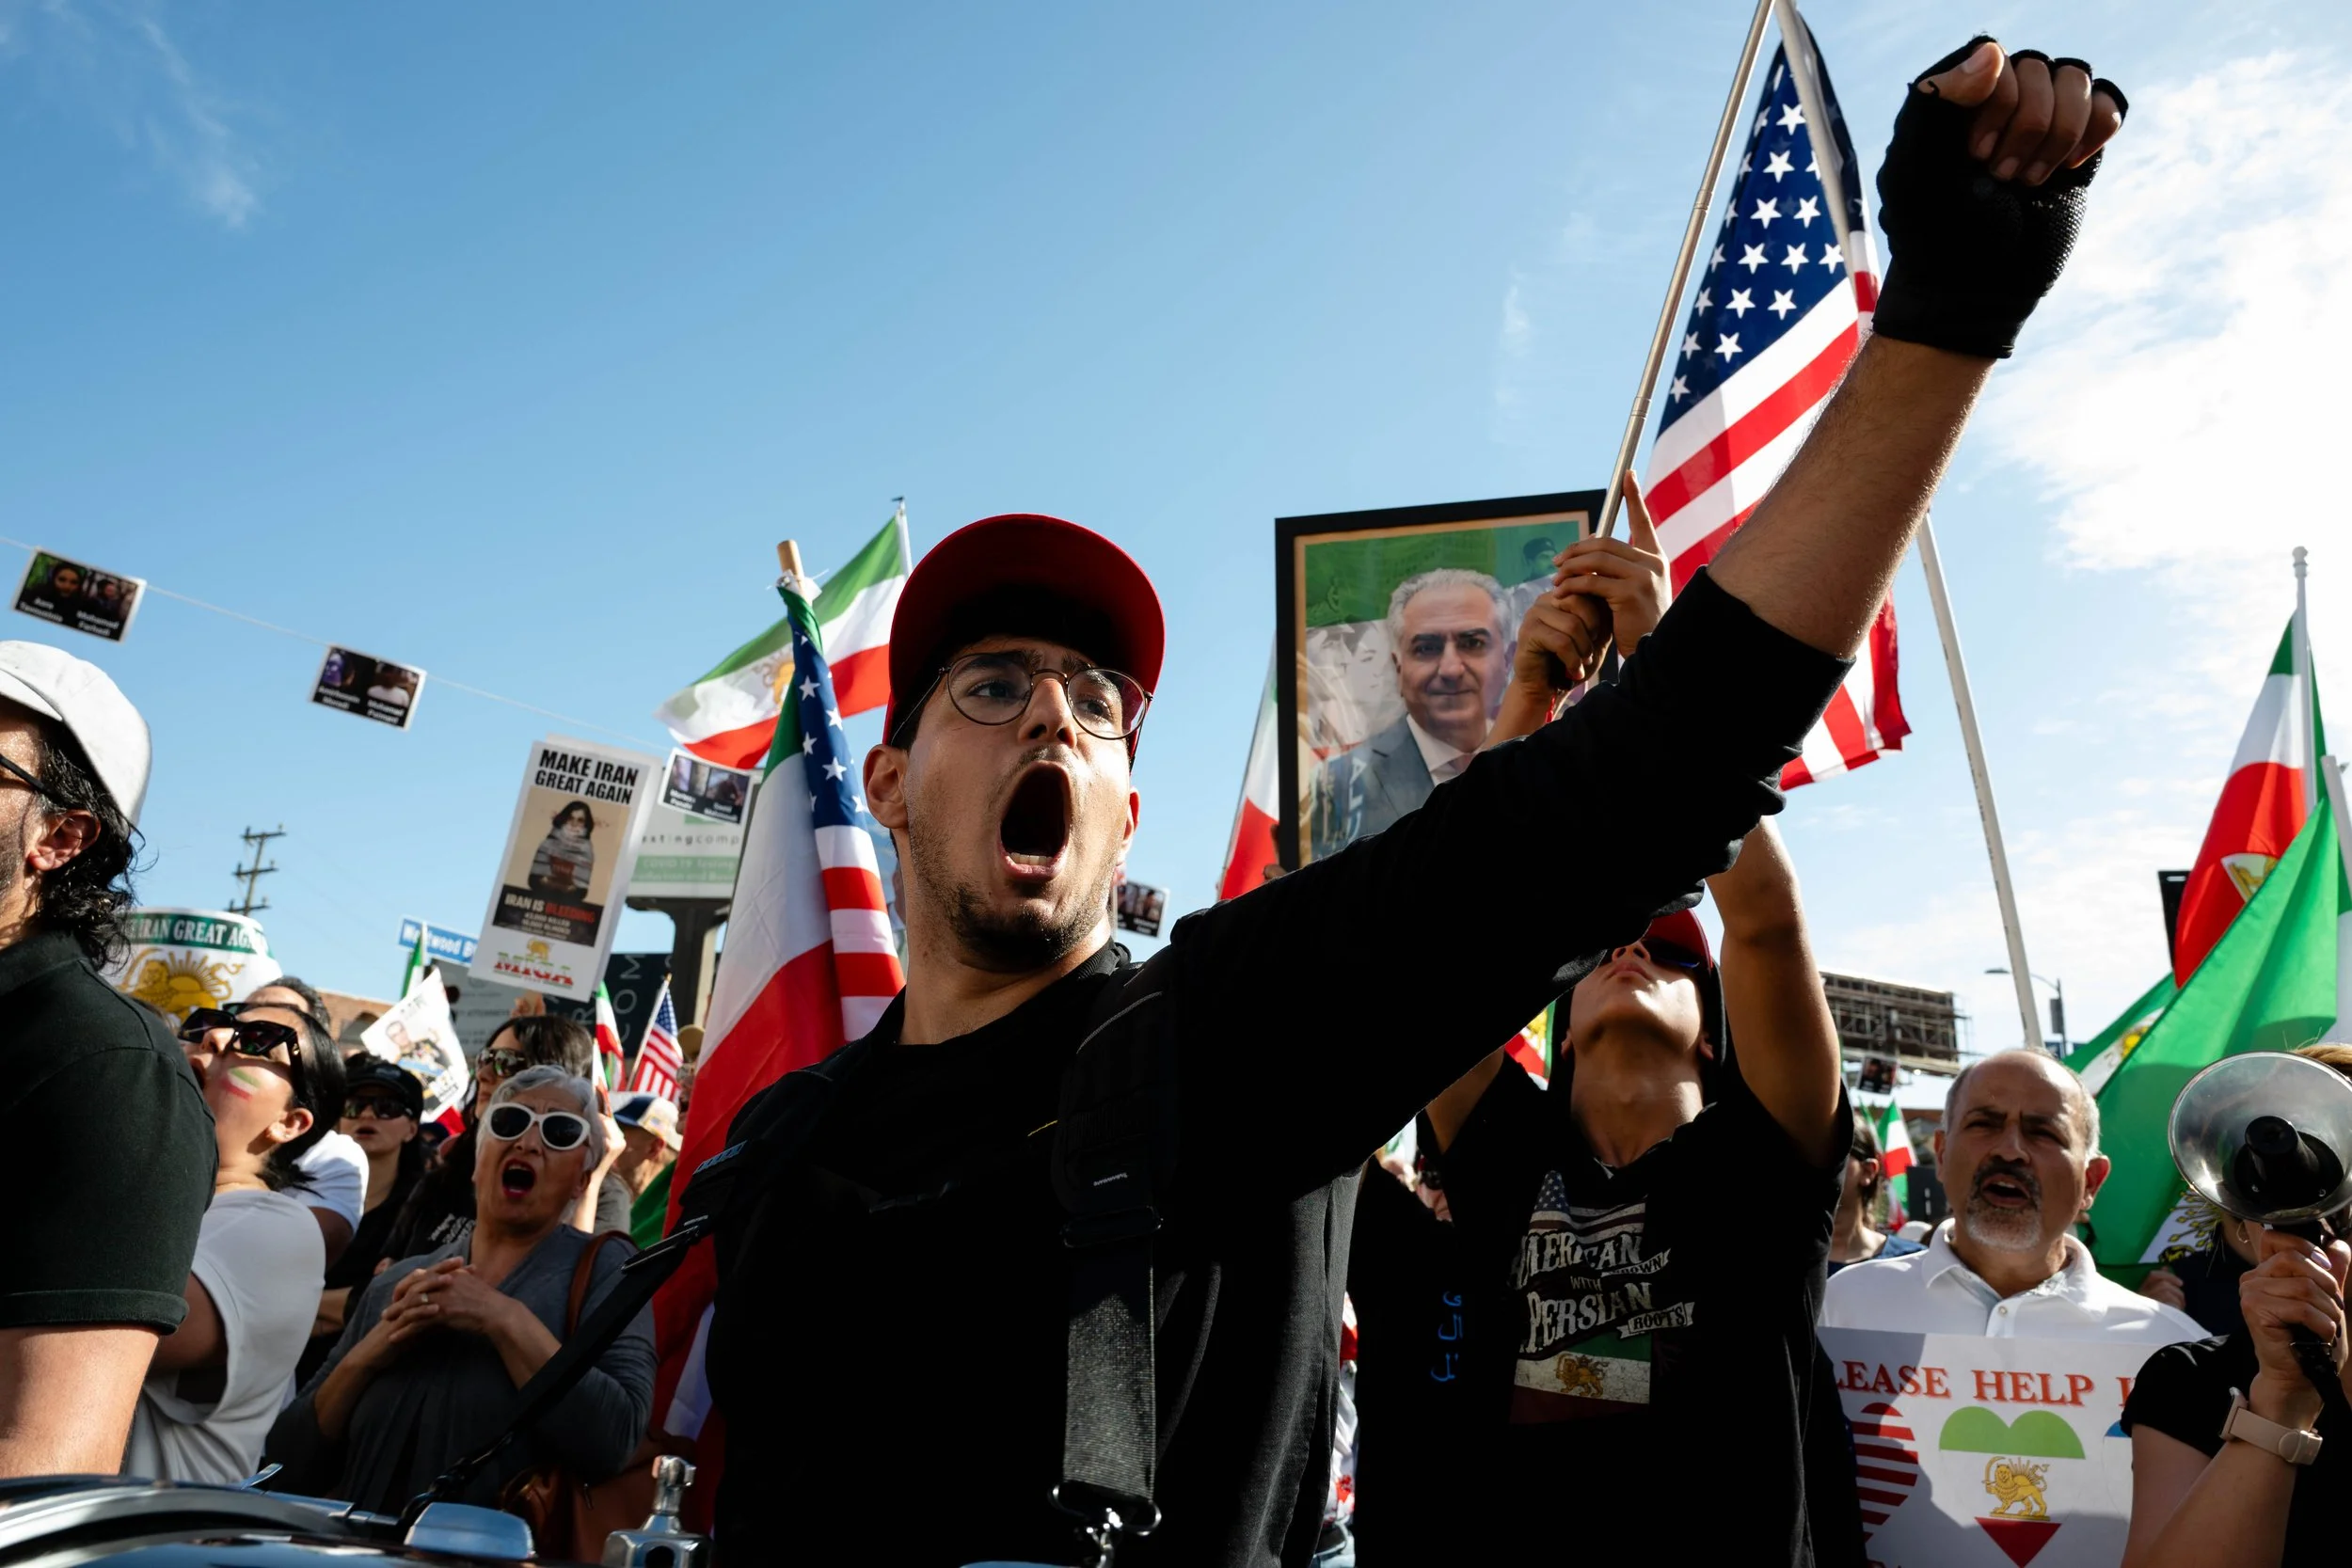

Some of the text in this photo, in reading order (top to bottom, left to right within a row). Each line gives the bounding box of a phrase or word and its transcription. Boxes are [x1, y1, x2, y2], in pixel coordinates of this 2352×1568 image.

[538, 749, 639, 787] MAKE IRAN
[534, 769, 633, 805] GREAT AGAIN
[504, 894, 532, 911] IRAN
[532, 899, 545, 912] IS
[139, 917, 172, 939] IRAN
[173, 920, 227, 945] GREAT
[1570, 1275, 1603, 1292] WITH
[1519, 1282, 1653, 1354] PERSIAN
[1633, 1306, 1685, 1332] ROOTS
[1971, 1369, 2095, 1407] HELP
